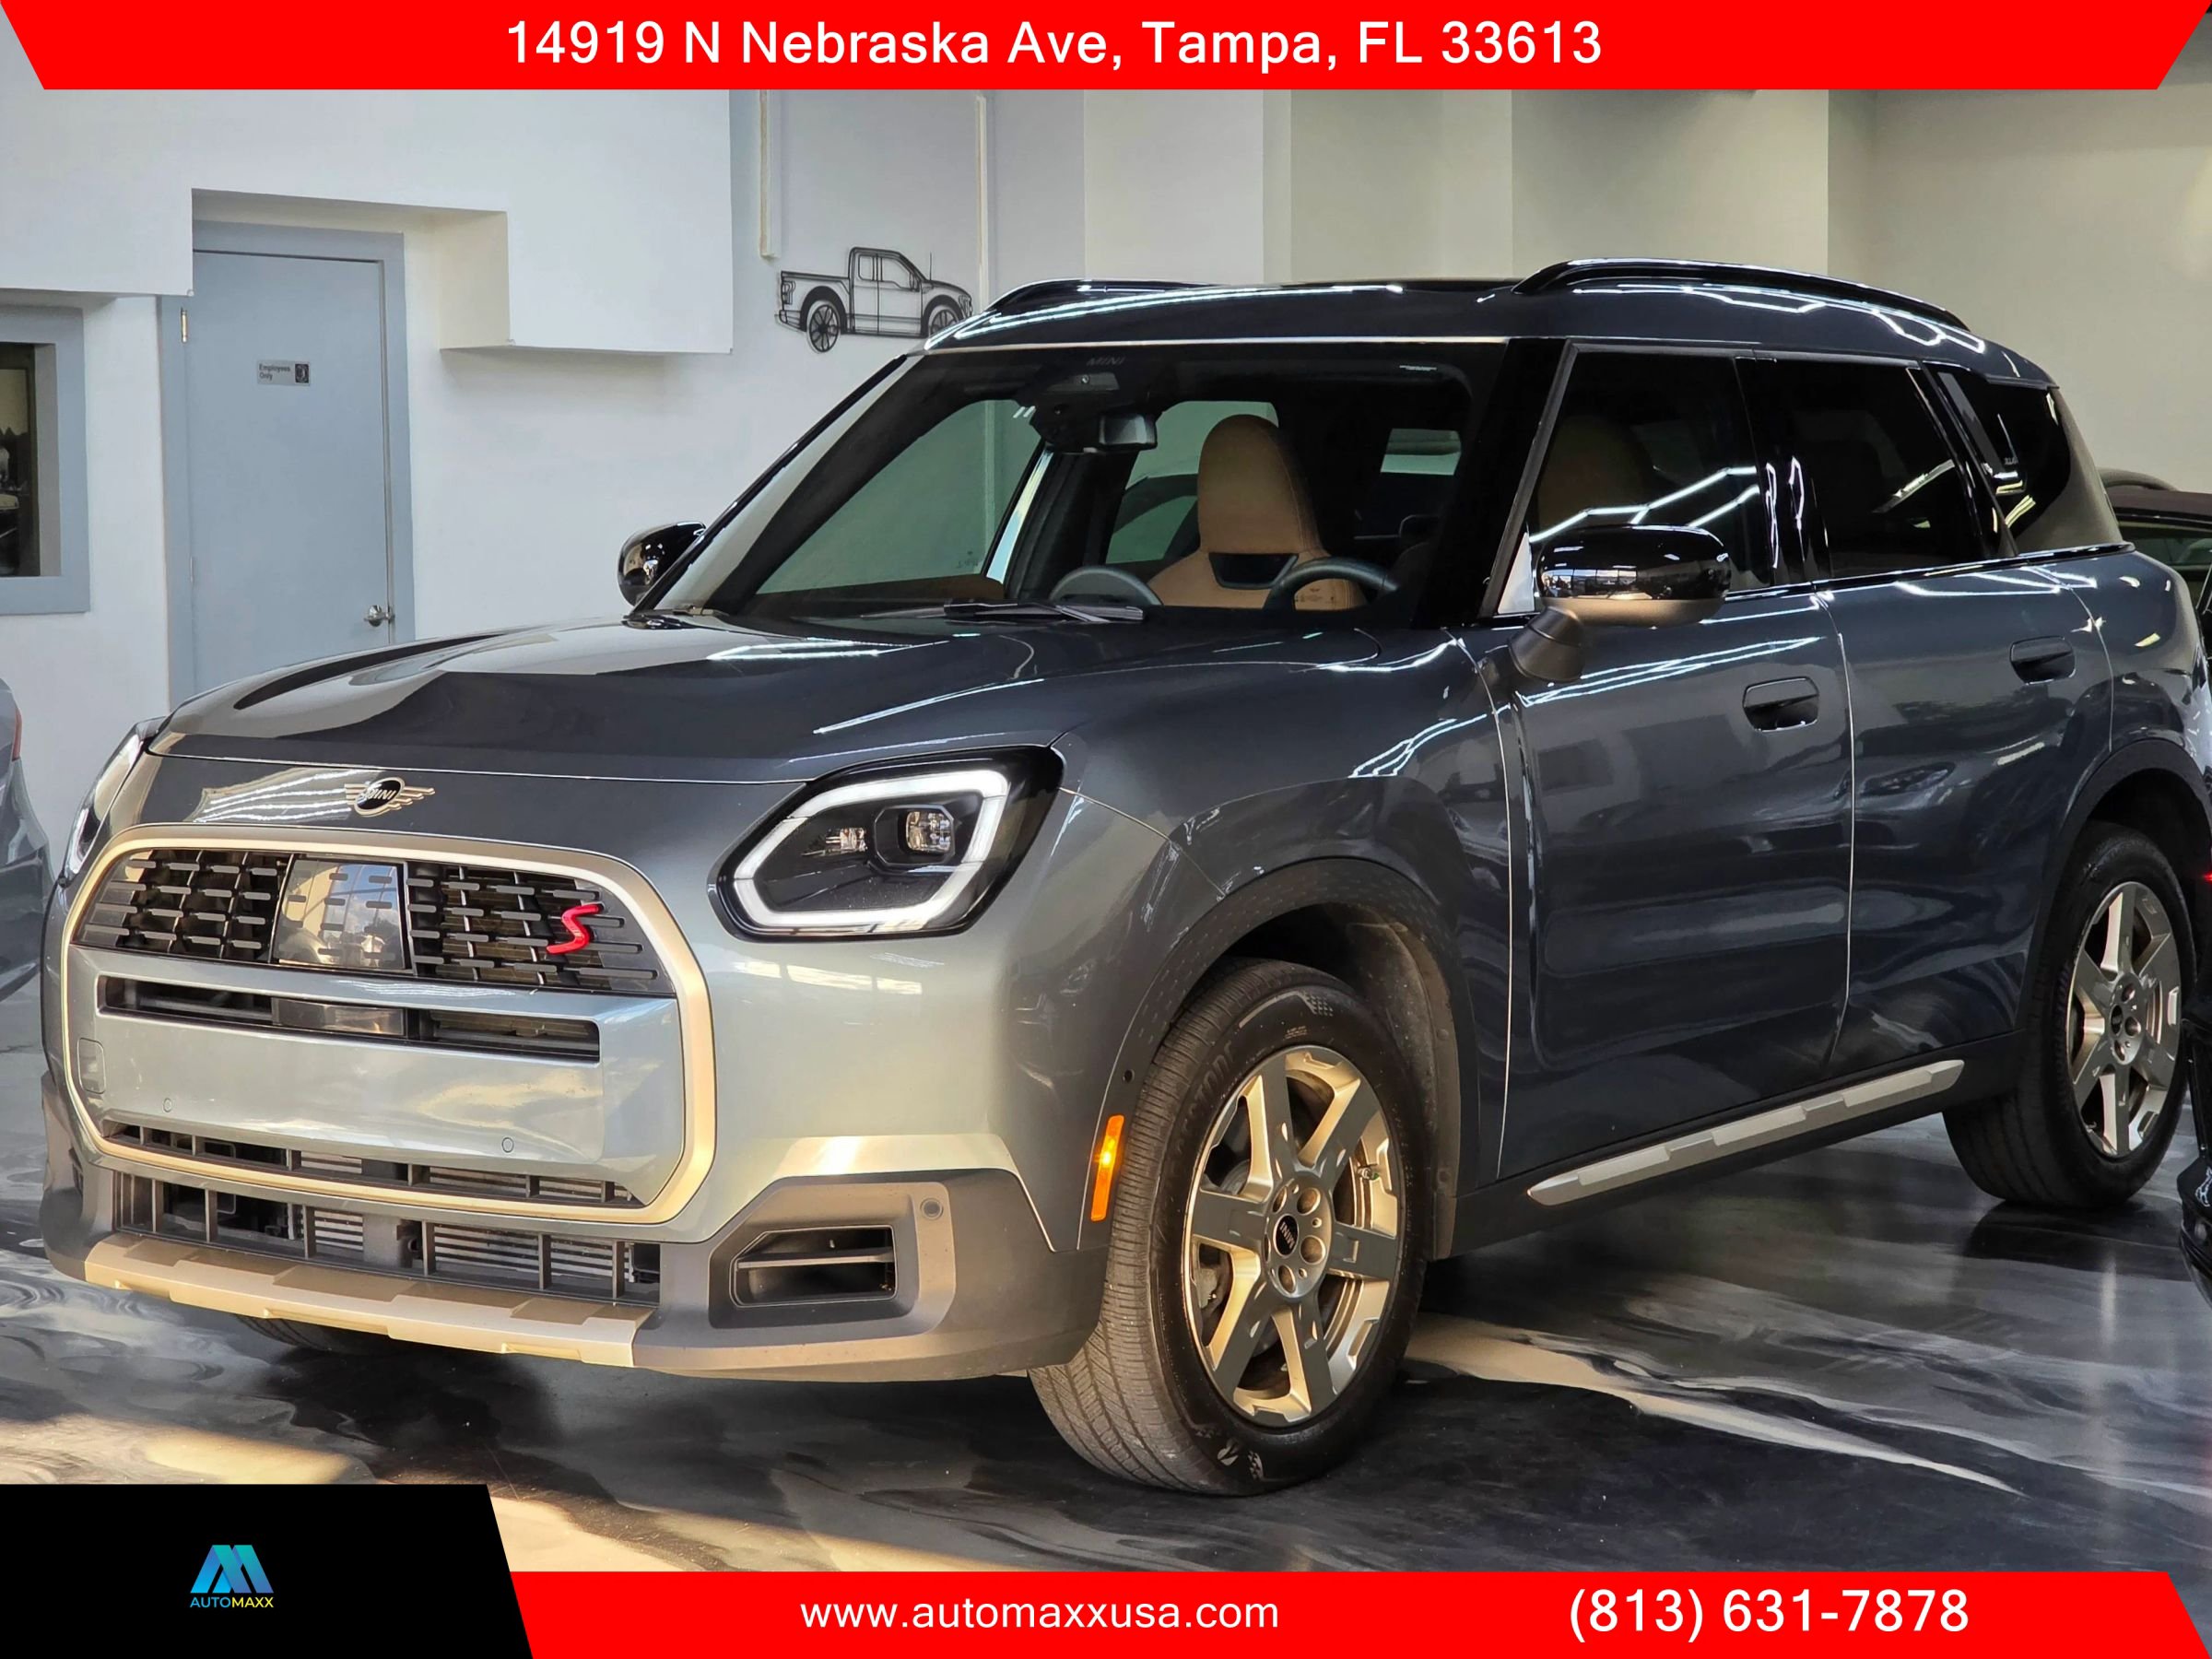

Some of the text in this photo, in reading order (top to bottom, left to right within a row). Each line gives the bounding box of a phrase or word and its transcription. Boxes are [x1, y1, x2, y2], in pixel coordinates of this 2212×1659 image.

[259, 371, 274, 381] Only
[546, 902, 599, 955] S
[1279, 1221, 1295, 1250] MINI
